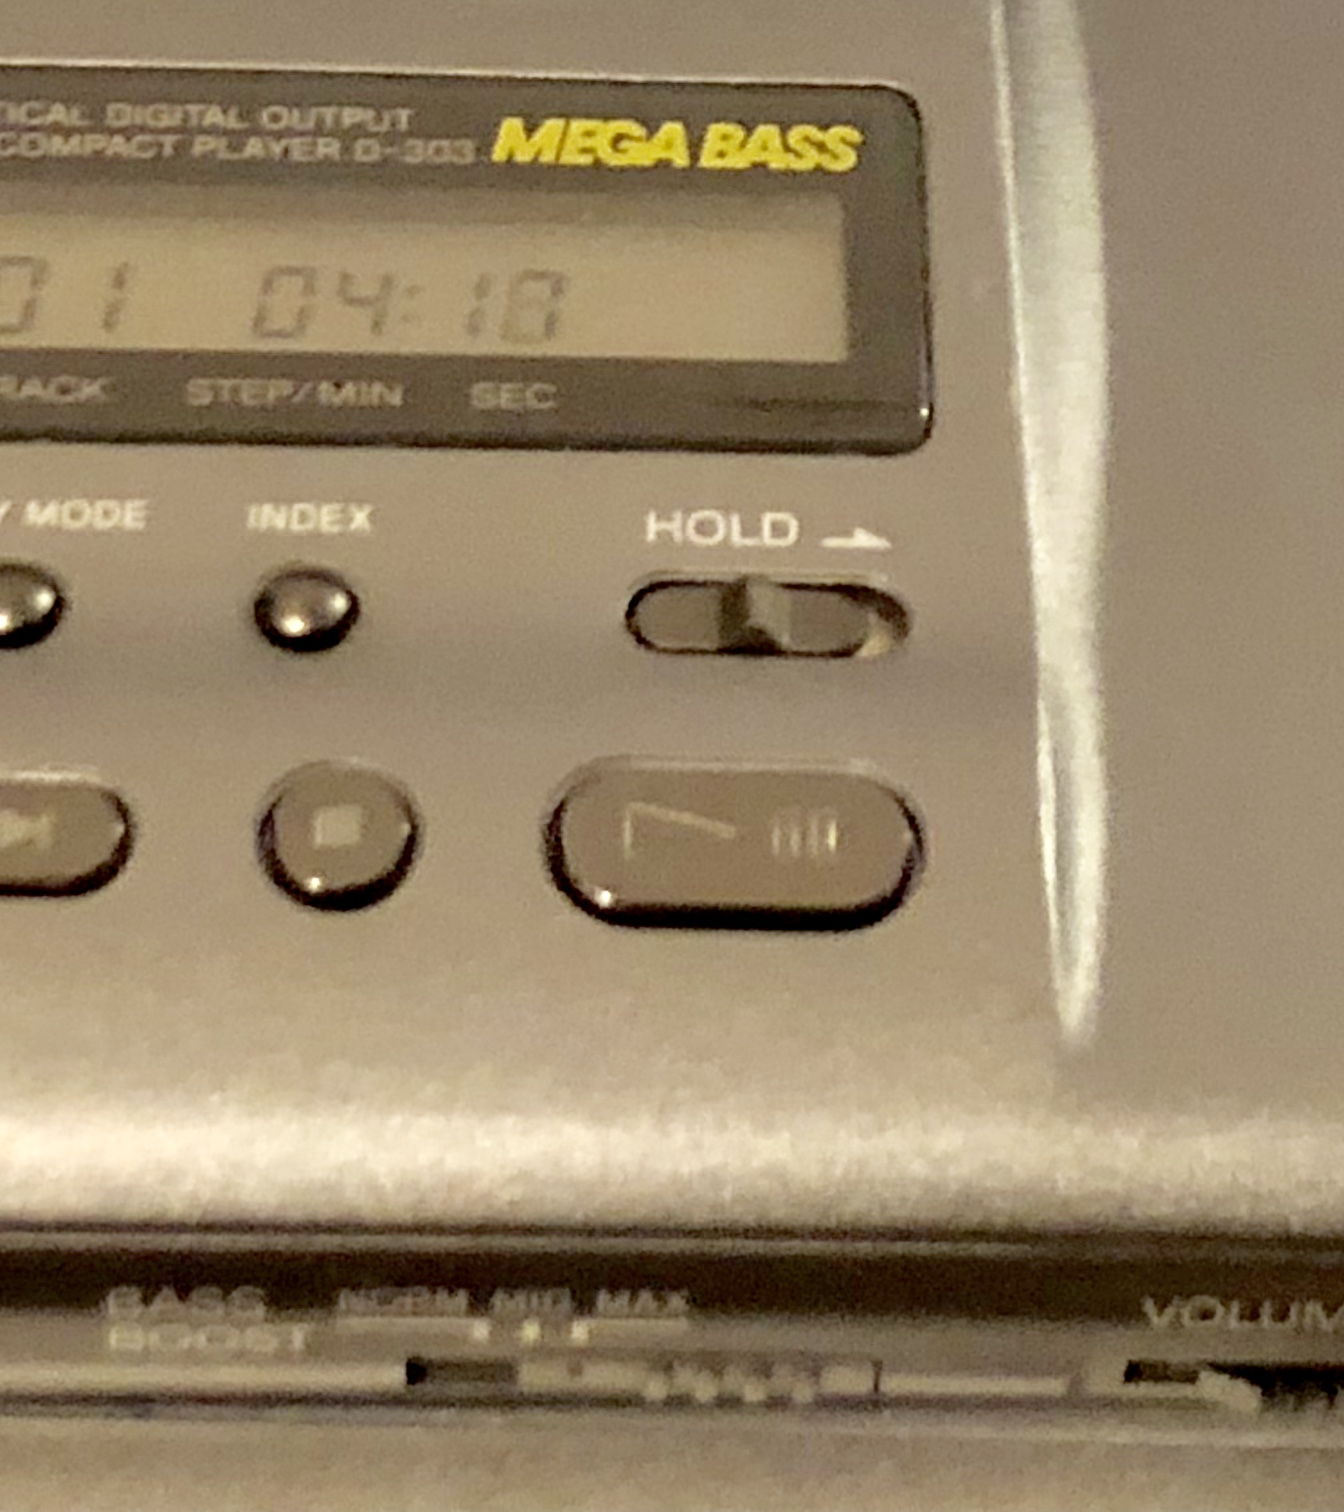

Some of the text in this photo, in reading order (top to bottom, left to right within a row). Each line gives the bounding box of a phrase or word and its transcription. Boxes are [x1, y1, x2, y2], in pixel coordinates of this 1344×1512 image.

[105, 102, 250, 131] DIGITAL
[259, 104, 415, 134] OUTPUT
[189, 134, 342, 162] PLAYER
[490, 116, 865, 172] MEGA BASS
[186, 376, 405, 409] STEP/MIN
[469, 380, 559, 411] SEC
[24, 497, 150, 531] MODE
[245, 501, 375, 534] INDEX
[645, 508, 800, 548] HOLD
